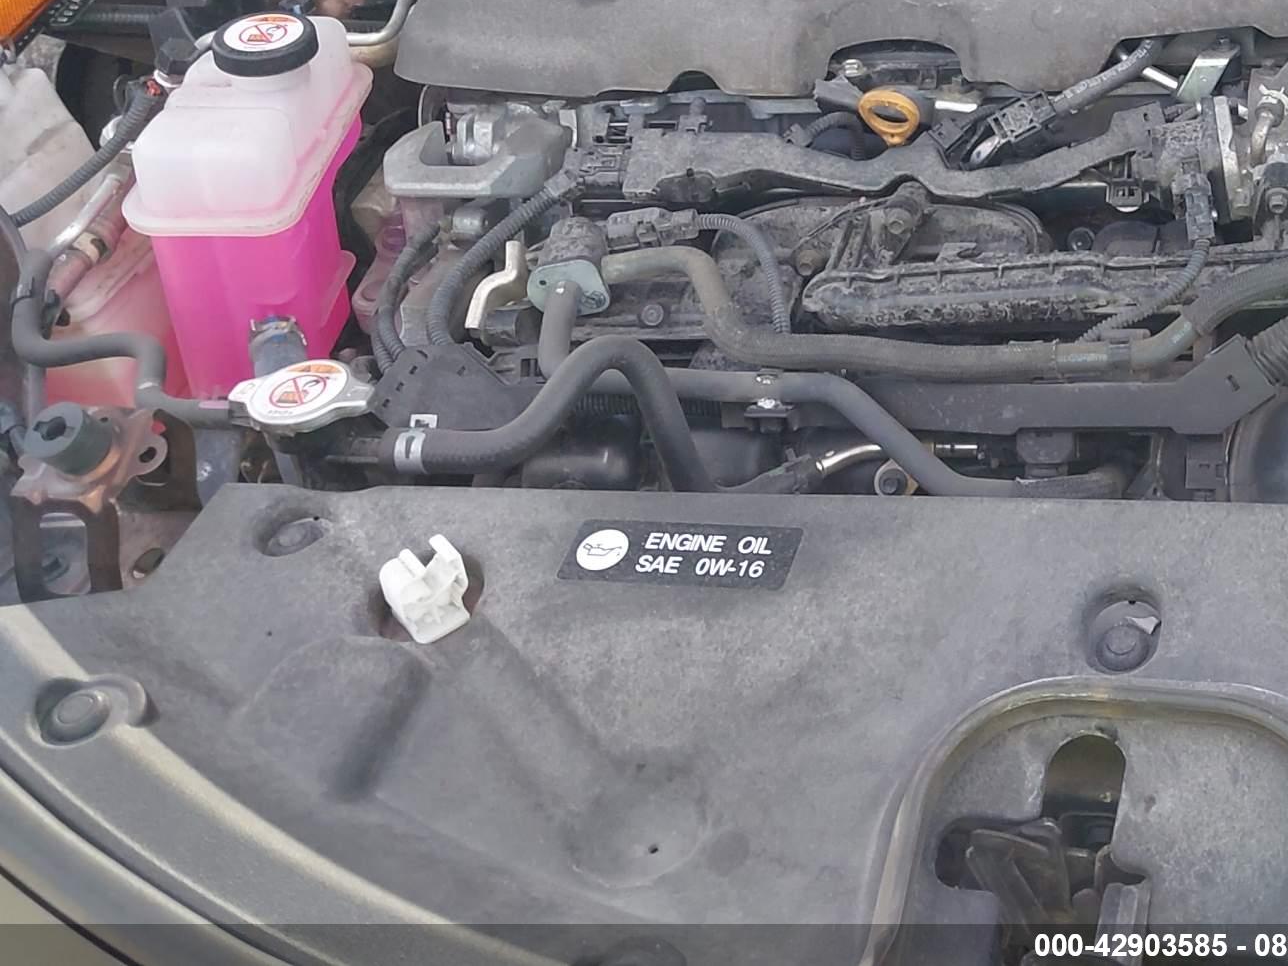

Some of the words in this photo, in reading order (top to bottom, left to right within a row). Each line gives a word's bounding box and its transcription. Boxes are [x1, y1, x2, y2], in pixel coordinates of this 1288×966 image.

[645, 532, 727, 553] ENGINE
[737, 536, 772, 555] OIL
[635, 554, 683, 574] SAE
[695, 557, 765, 578] 0W-16
